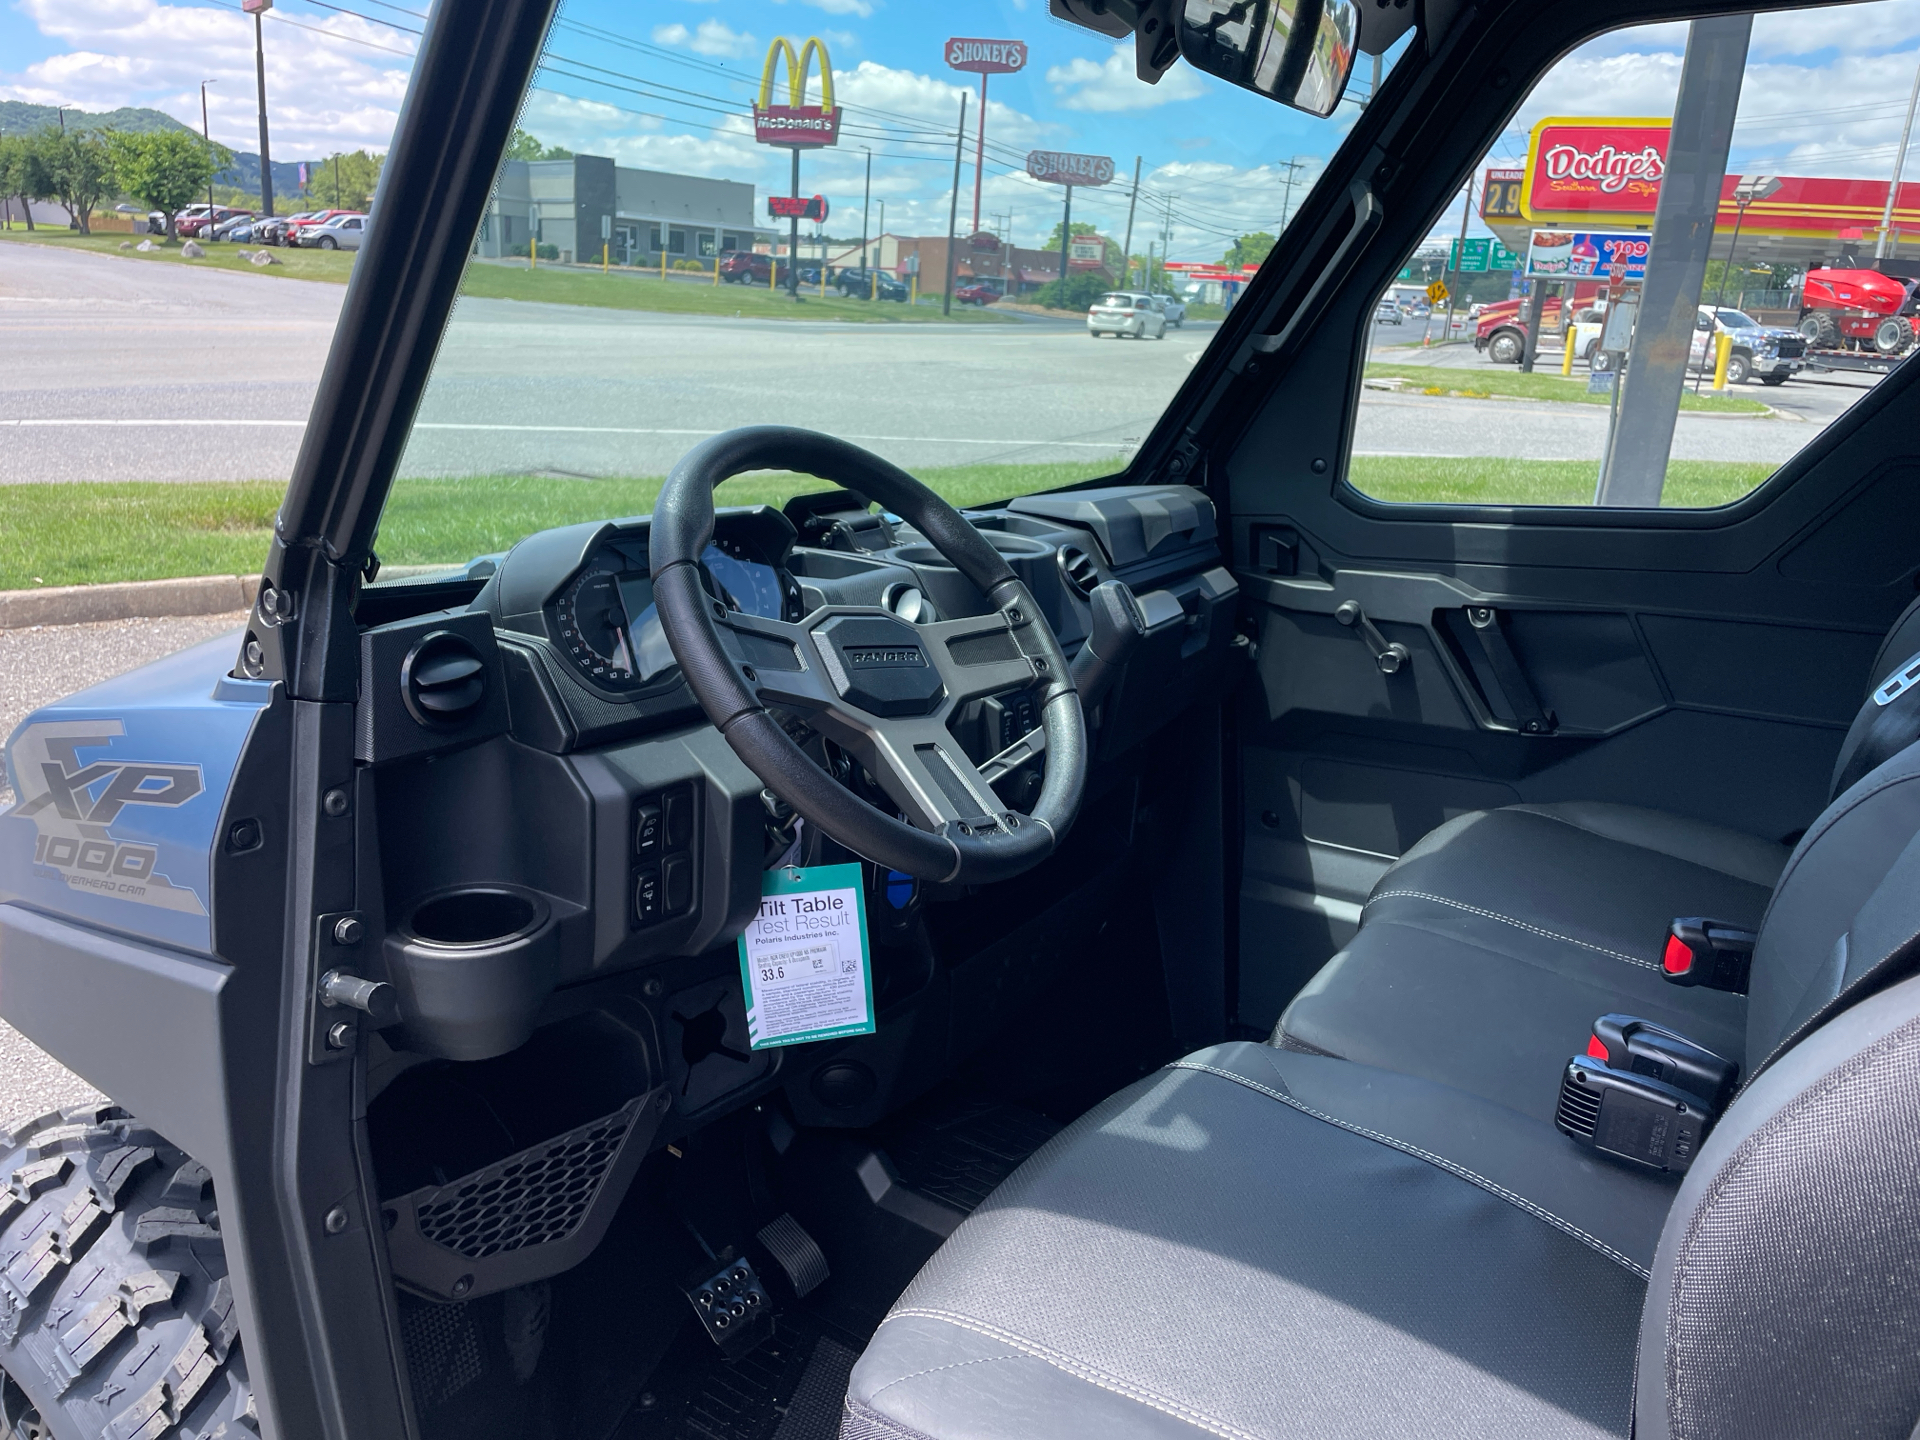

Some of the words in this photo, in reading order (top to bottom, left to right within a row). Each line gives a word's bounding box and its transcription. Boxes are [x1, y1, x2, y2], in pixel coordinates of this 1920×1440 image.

[950, 42, 1022, 68] SHONEY'S
[757, 117, 832, 130] McDonald's
[1491, 170, 1525, 180] UNLEADE
[1545, 144, 1666, 193] Dodge's
[1550, 180, 1597, 192] Southern
[1628, 181, 1658, 197] Style
[1486, 183, 1521, 214] 2.9
[1569, 263, 1592, 276] ICEE
[1610, 262, 1626, 279] STOP
[852, 652, 919, 663] RANGER
[12, 761, 203, 825] XP
[33, 833, 157, 880] 1000
[59, 872, 116, 891] OVERHEAD
[118, 883, 146, 897] CAM
[760, 900, 786, 917] Tilt
[791, 895, 844, 914] Table
[752, 917, 790, 935] Test
[795, 911, 850, 931] Result
[755, 936, 783, 945] Polaris
[784, 932, 823, 942] Industries
[761, 966, 785, 981] 33.6
